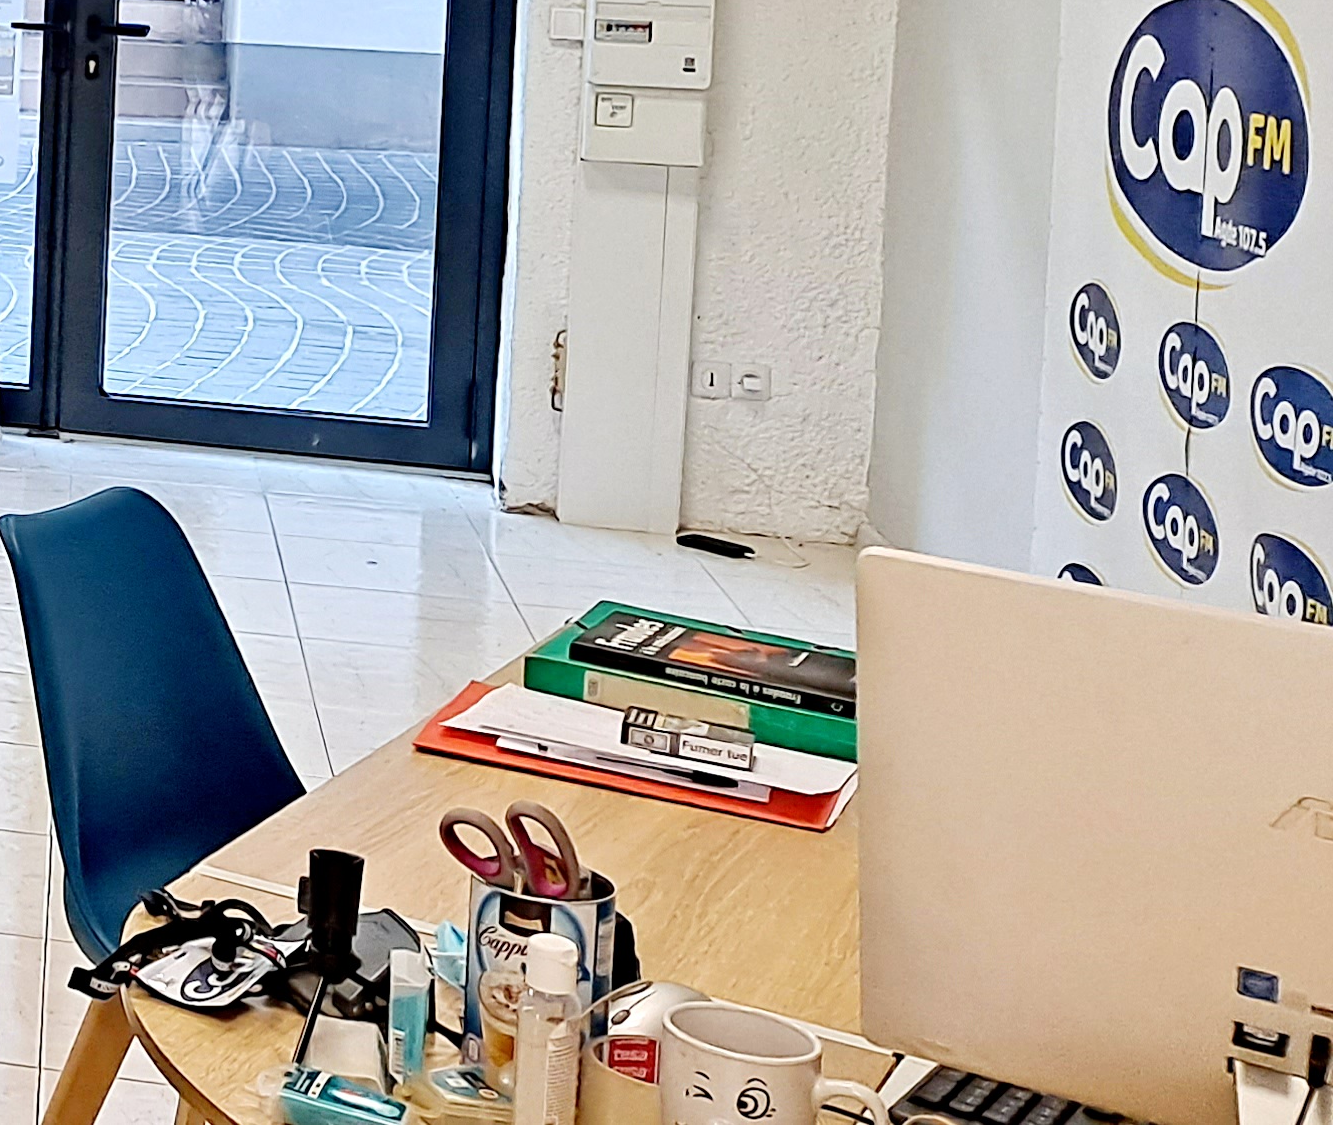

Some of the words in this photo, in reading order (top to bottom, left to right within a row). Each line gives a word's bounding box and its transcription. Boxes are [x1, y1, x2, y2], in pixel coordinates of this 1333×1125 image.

[1120, 35, 1243, 237] Cap
[1247, 113, 1292, 175] FM
[1214, 216, 1237, 247] Agde
[1238, 226, 1268, 257] 107.5
[1074, 292, 1107, 367] Cap
[1164, 332, 1210, 415] Cap
[1254, 377, 1320, 471] Cap
[1322, 424, 1333, 450] F
[1065, 429, 1104, 507] Cap
[1148, 482, 1199, 569] Cap
[1252, 542, 1304, 621] Cap
[682, 735, 722, 756] Fumer
[727, 746, 747, 761] tue
